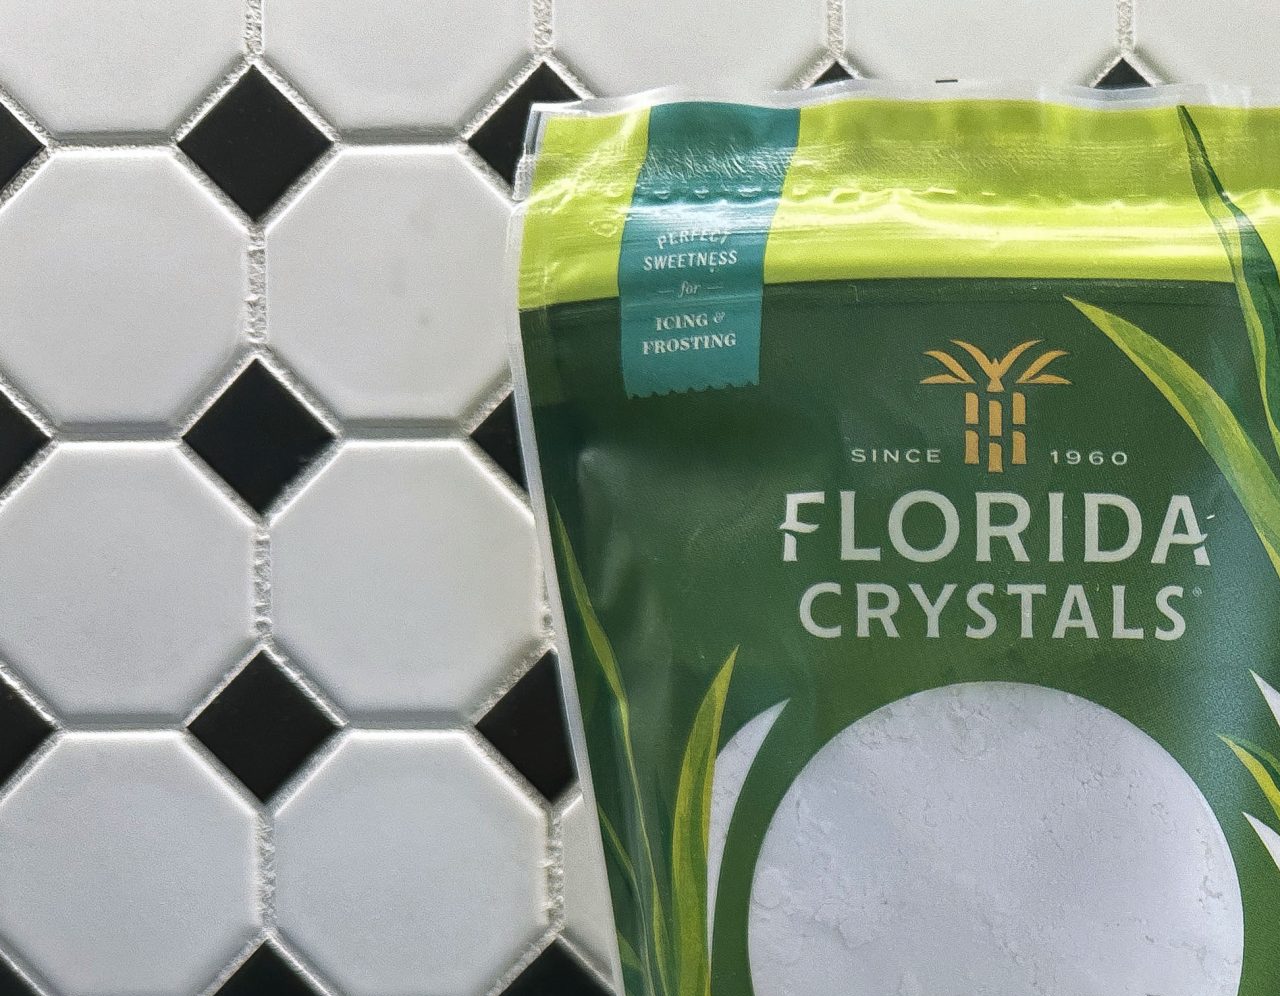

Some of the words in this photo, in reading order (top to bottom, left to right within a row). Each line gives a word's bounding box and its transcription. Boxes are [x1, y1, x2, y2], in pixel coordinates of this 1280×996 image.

[657, 230, 731, 249] PERFECT
[644, 250, 738, 271] SWEETNESS
[678, 281, 701, 298] for
[656, 313, 708, 331] ICING
[642, 333, 737, 355] FROSTING
[851, 448, 942, 463] SINCE
[1050, 450, 1128, 466] 1960
[779, 489, 1211, 566] FLORIDA
[799, 581, 1187, 641] CRYSTALS
